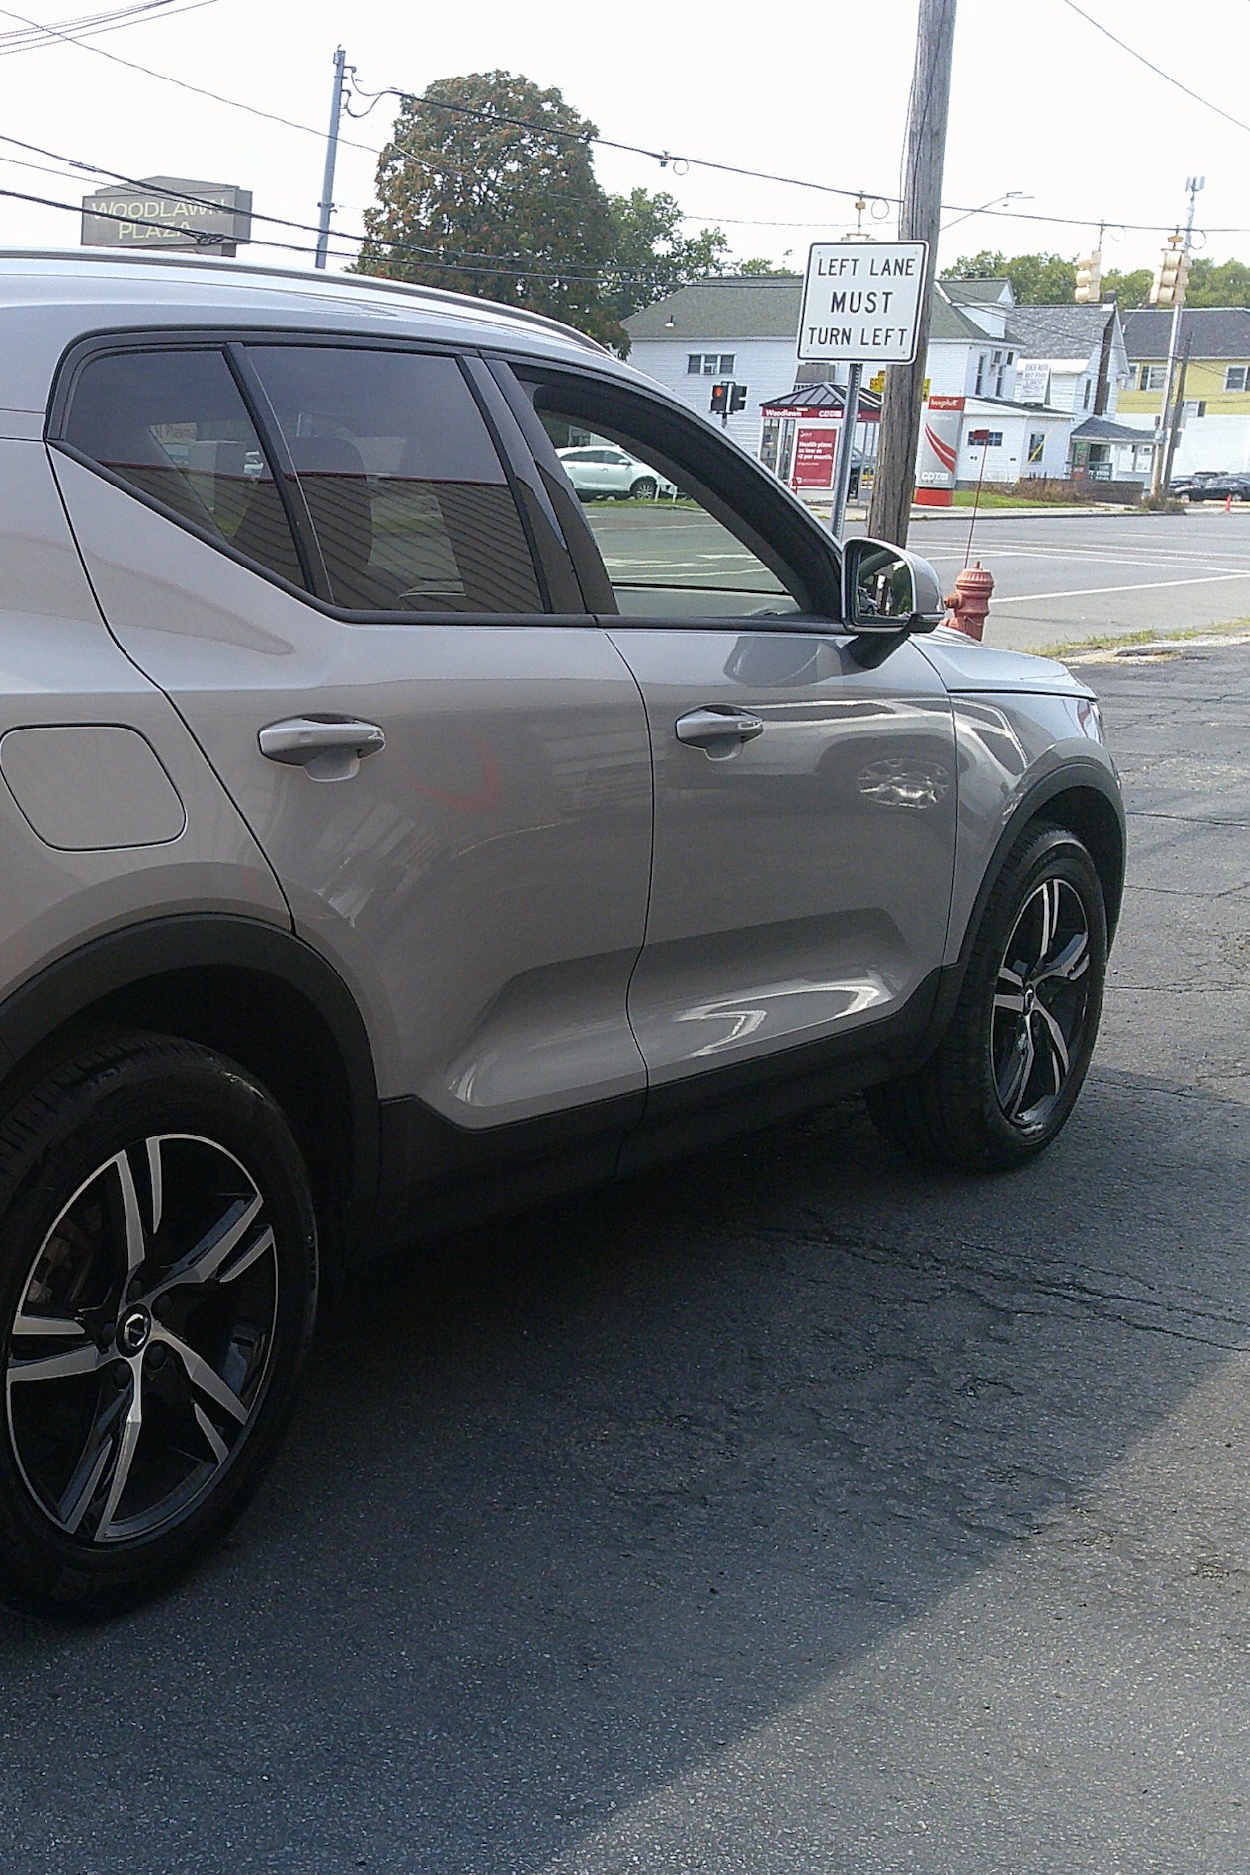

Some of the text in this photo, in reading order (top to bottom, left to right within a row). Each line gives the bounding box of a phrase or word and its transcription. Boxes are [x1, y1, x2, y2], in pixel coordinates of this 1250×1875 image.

[91, 198, 226, 219] WOODLAWN
[118, 221, 193, 239] PLAZA
[817, 258, 916, 276] LEFT LANE
[830, 291, 894, 314] MUST
[808, 327, 908, 346] TURN LEFT
[765, 408, 802, 417] Woodlawn
[817, 441, 833, 449] plans
